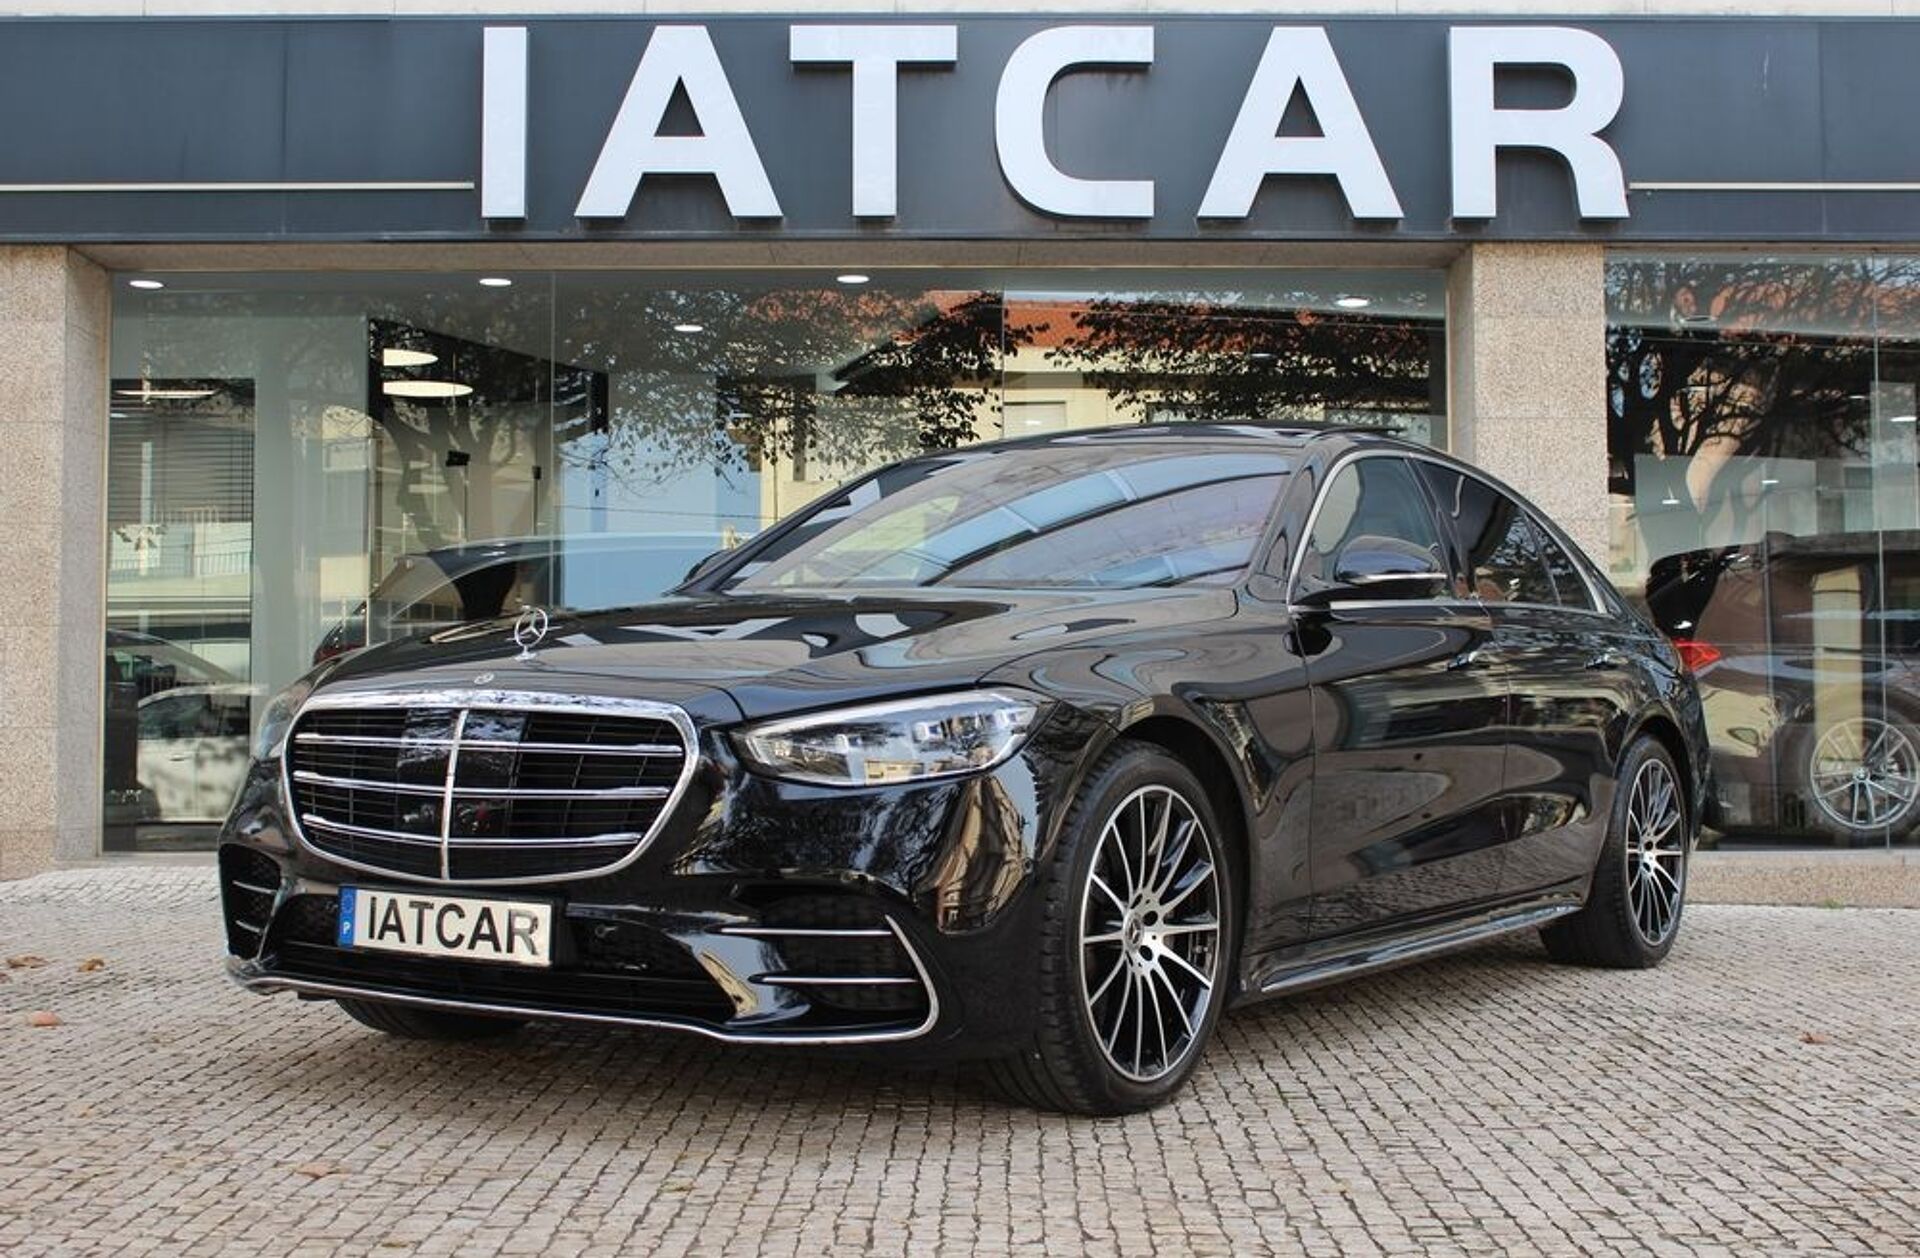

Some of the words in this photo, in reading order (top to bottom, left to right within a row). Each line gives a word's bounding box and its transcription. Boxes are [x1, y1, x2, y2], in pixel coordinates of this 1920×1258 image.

[481, 25, 1630, 220] IATCAR
[343, 921, 351, 935] P
[368, 896, 539, 955] IATCAR
